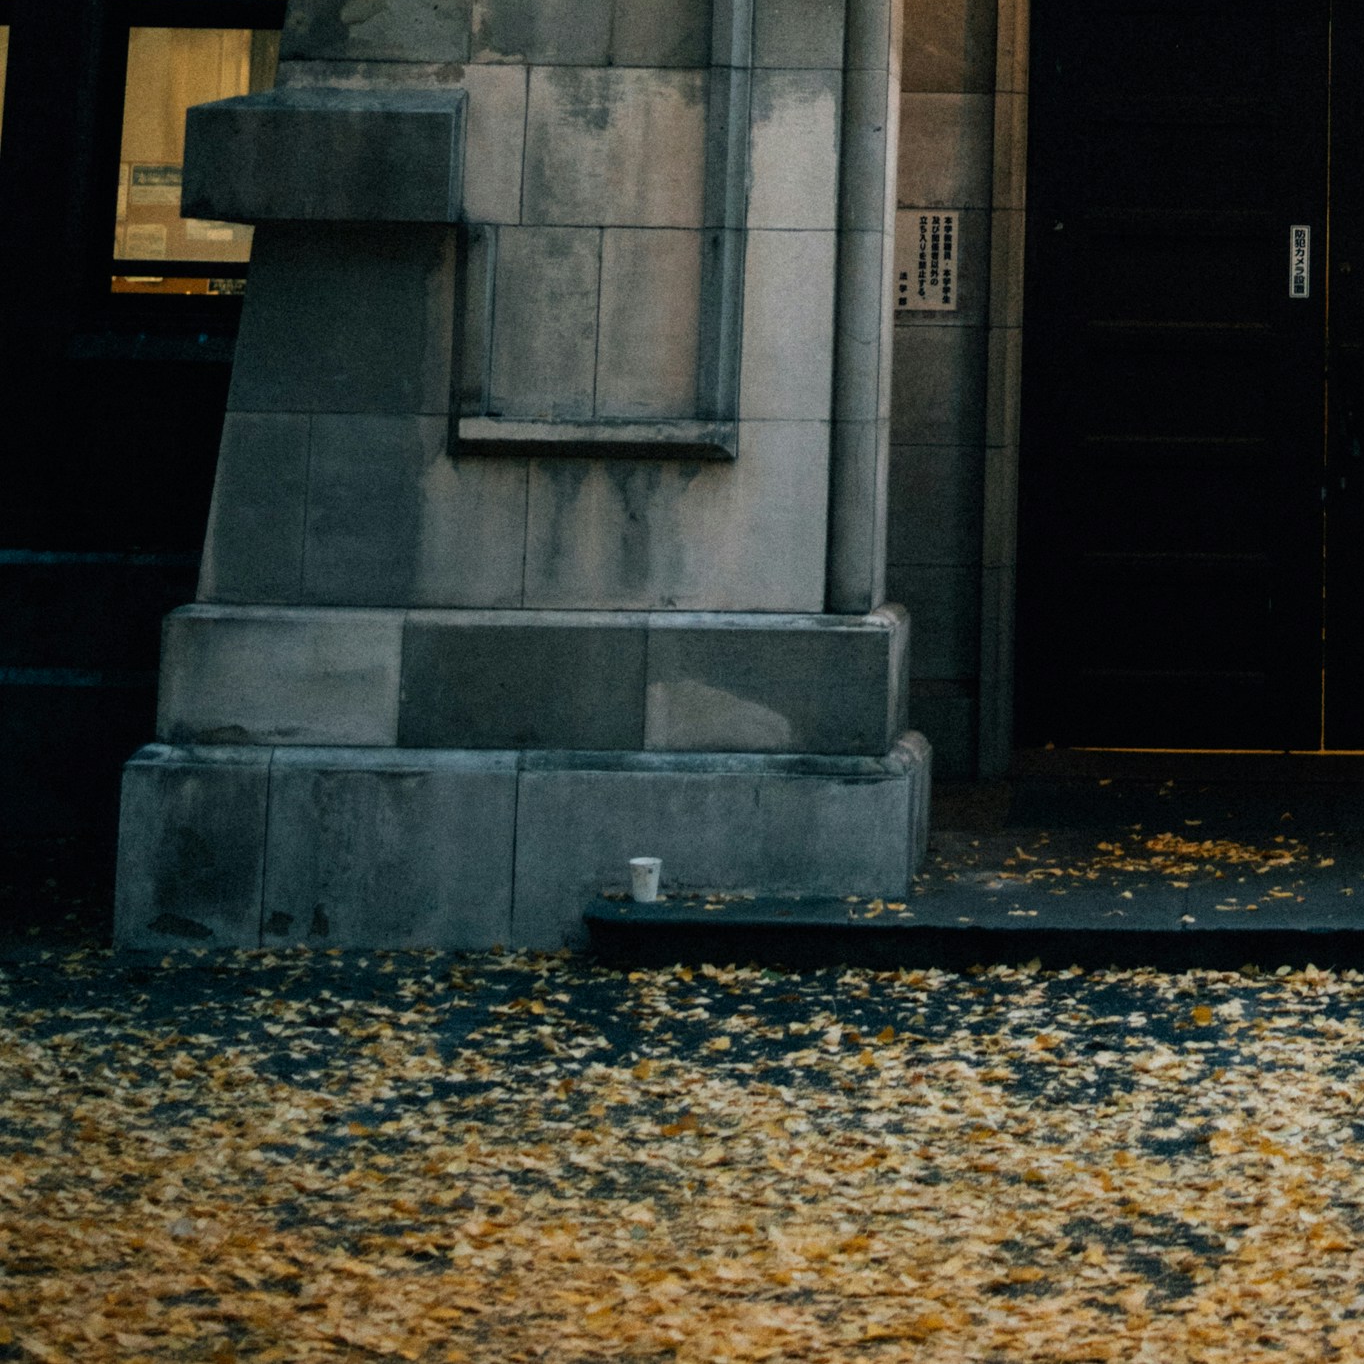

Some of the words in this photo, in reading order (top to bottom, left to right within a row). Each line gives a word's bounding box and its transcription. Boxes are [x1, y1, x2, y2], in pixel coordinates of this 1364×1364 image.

[1294, 230, 1306, 294] 防犯カメラ設置
